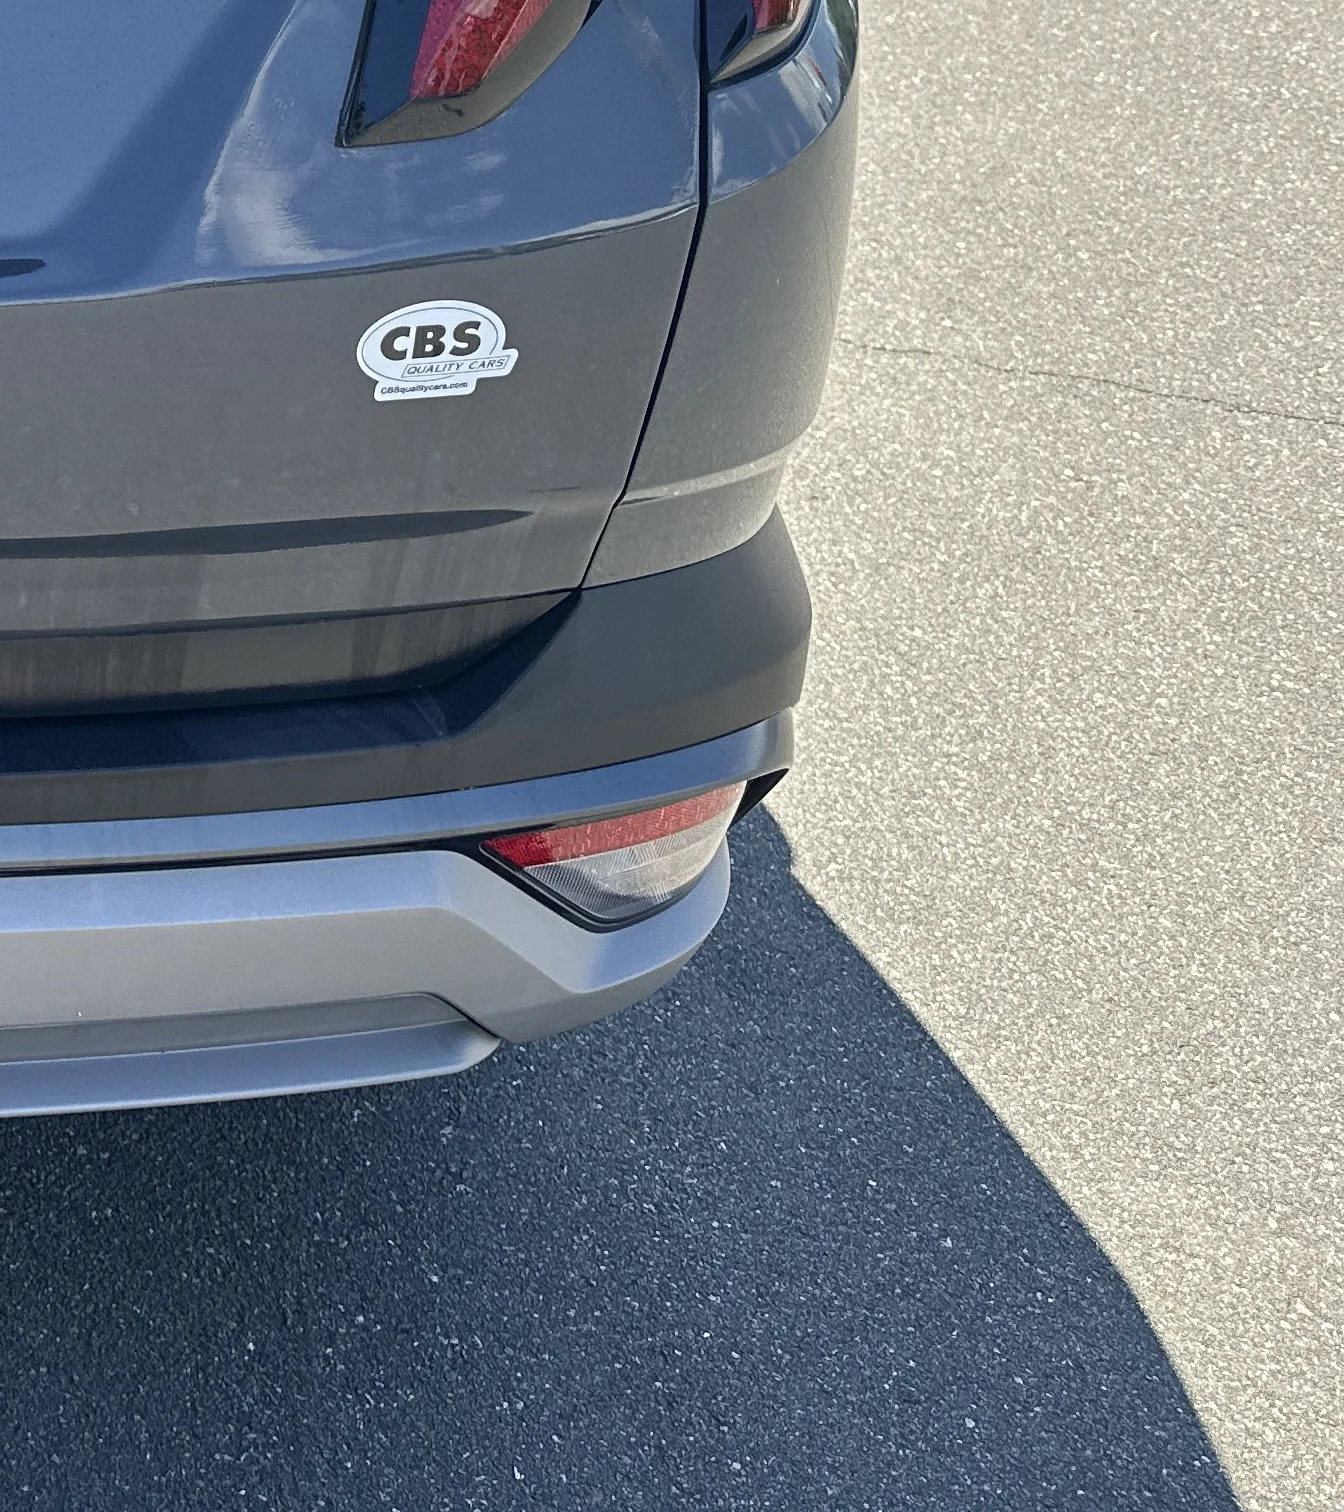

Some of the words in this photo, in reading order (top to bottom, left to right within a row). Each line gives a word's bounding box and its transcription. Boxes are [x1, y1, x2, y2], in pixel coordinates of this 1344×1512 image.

[380, 320, 482, 361] CBS
[406, 361, 465, 376] QUALITY
[468, 357, 506, 370] CARS
